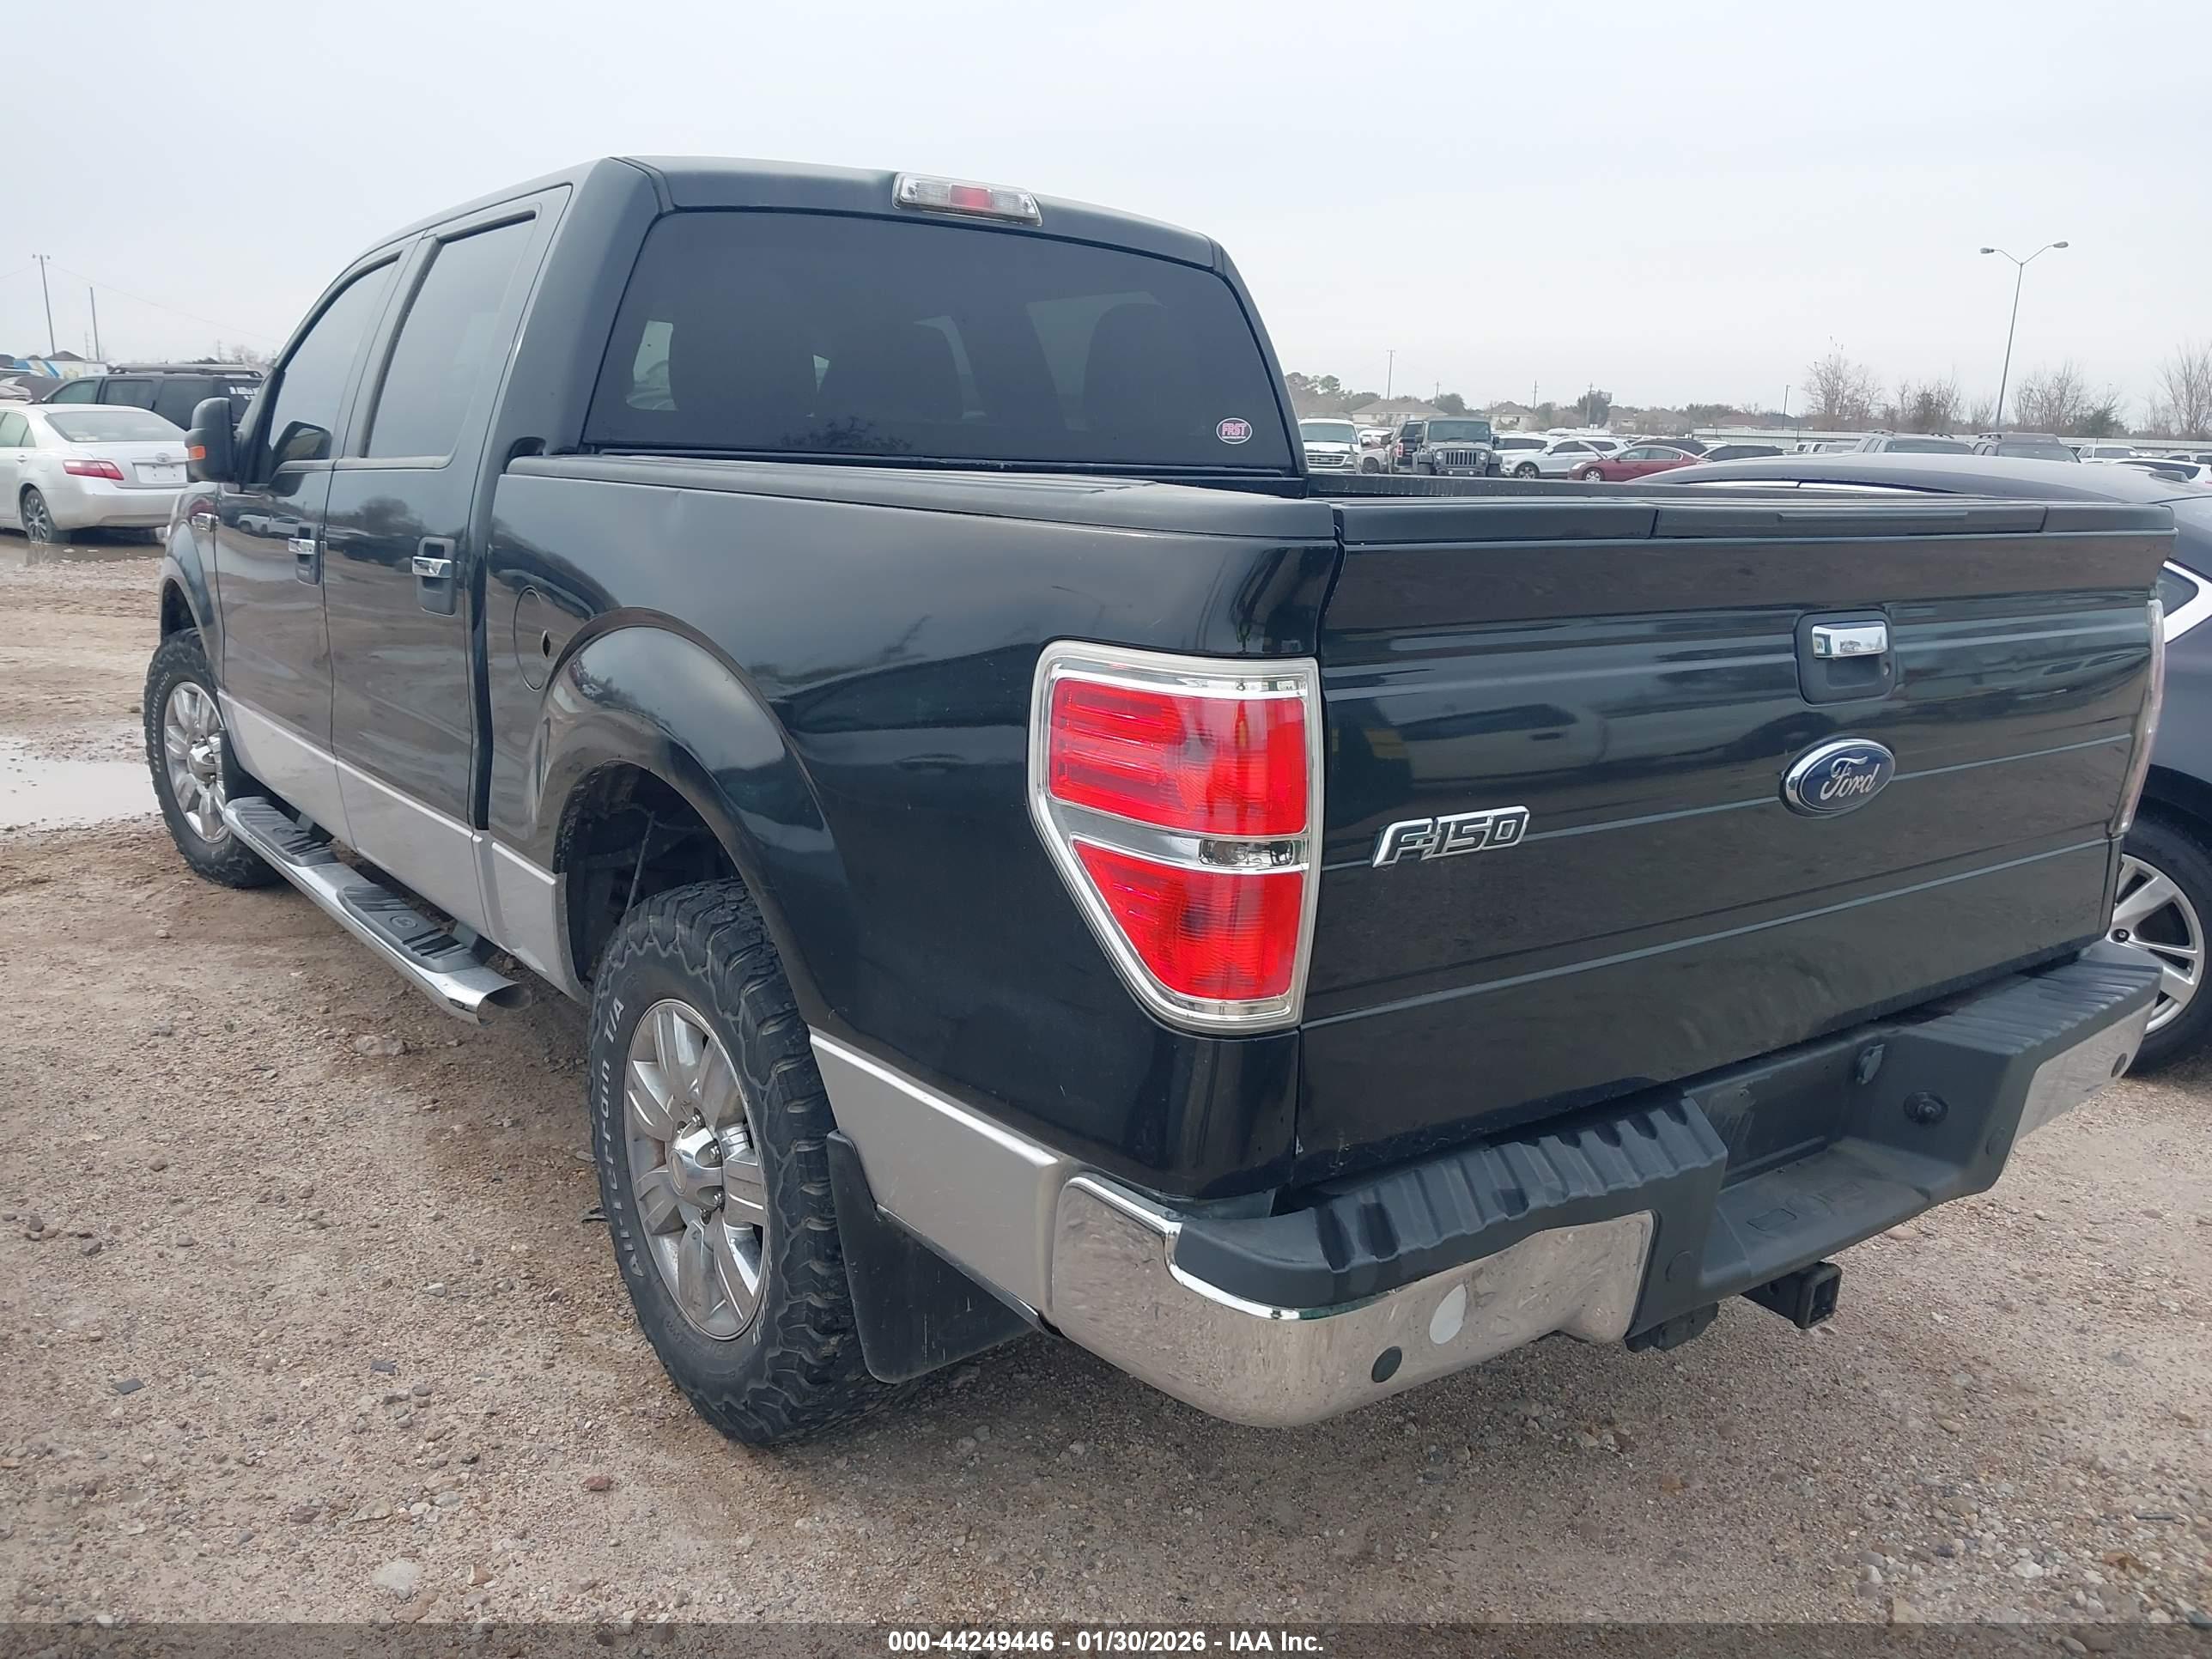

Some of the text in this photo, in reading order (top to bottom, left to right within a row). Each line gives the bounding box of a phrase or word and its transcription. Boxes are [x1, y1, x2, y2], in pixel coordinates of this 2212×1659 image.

[1820, 756, 1881, 800] Ford
[1371, 805, 1529, 867] F-150
[604, 996, 625, 1044] T/A
